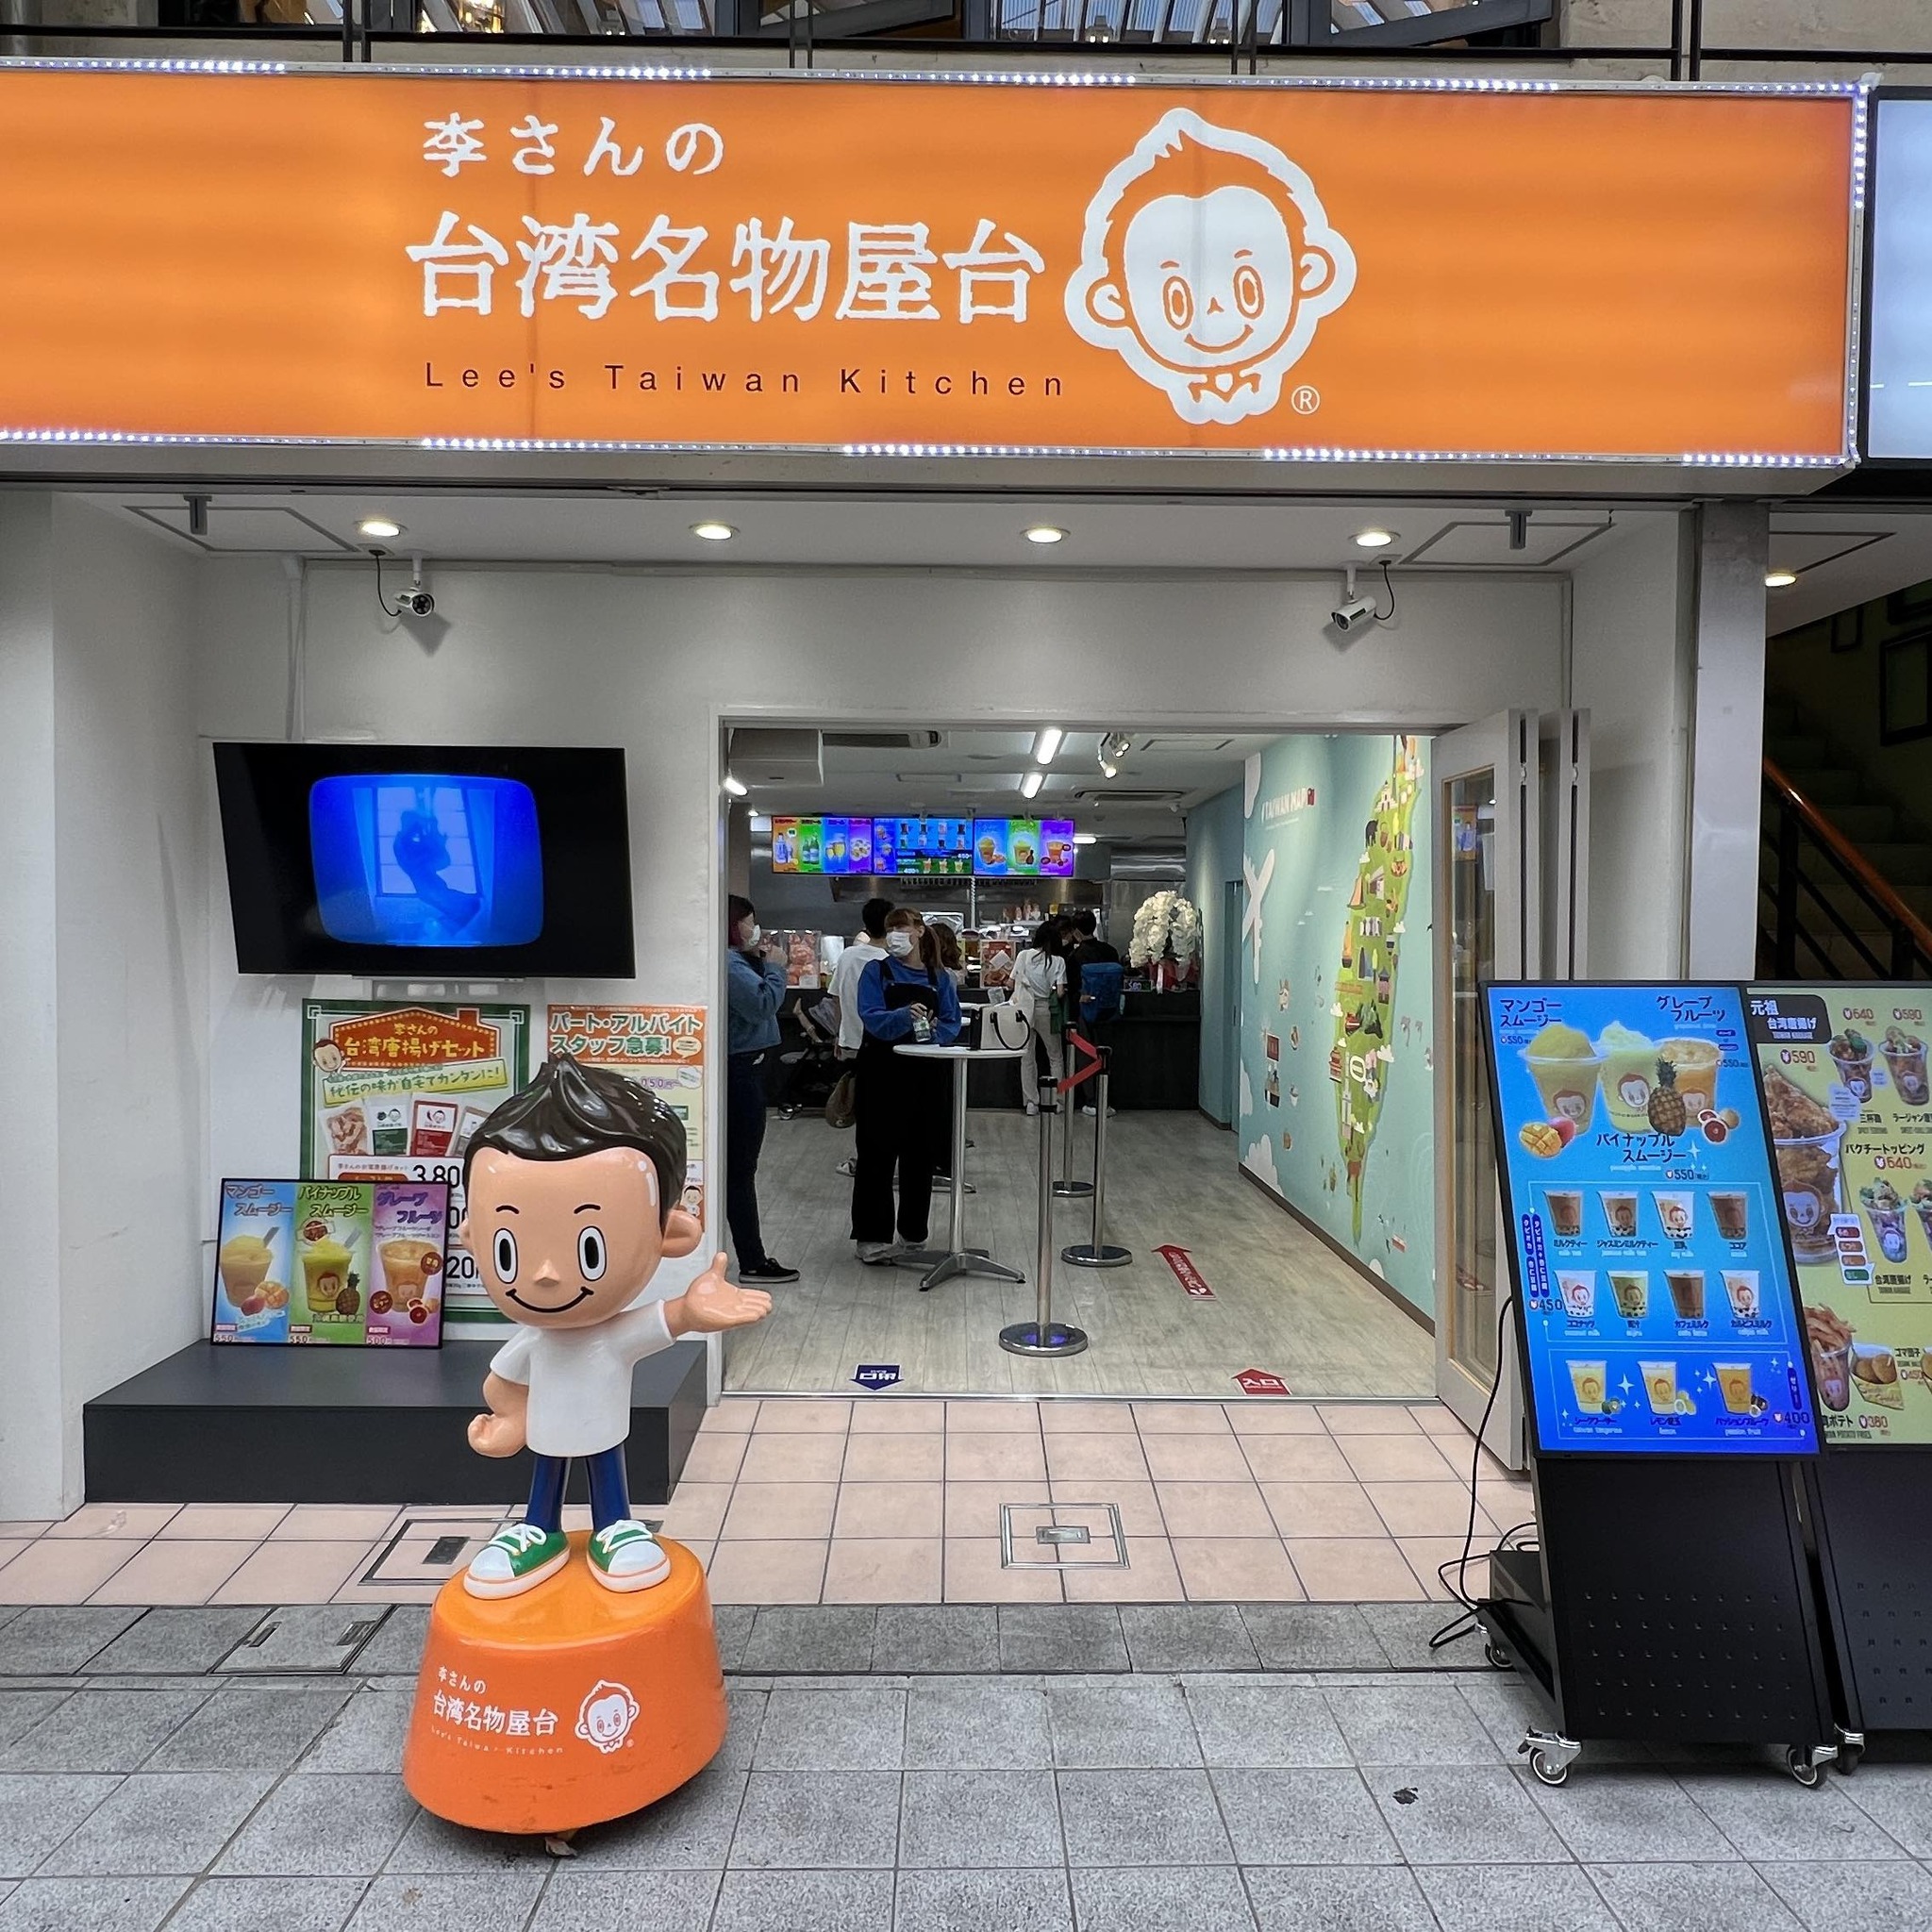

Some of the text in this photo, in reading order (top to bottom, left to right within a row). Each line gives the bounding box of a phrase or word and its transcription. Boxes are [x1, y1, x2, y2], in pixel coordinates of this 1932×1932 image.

[424, 112, 724, 176] 李さんの
[406, 210, 1044, 324] 台湾名物屋台
[425, 361, 1063, 397] Lee's Taiwan Kitchen
[1500, 997, 1562, 1012] マンゴー
[1657, 996, 1712, 1009] グレープ
[1500, 1014, 1562, 1027] スムージー
[1671, 1009, 1725, 1022] フルーツ
[344, 1037, 485, 1058] 台湾唐揚げセット
[1791, 1051, 1815, 1063] 590
[1596, 1133, 1674, 1147] パイナップル
[1623, 1149, 1686, 1163] スムージー
[1887, 1157, 1912, 1169] 640
[438, 1665, 487, 1694] 李さんの
[432, 1689, 558, 1736] 台湾名物屋台
